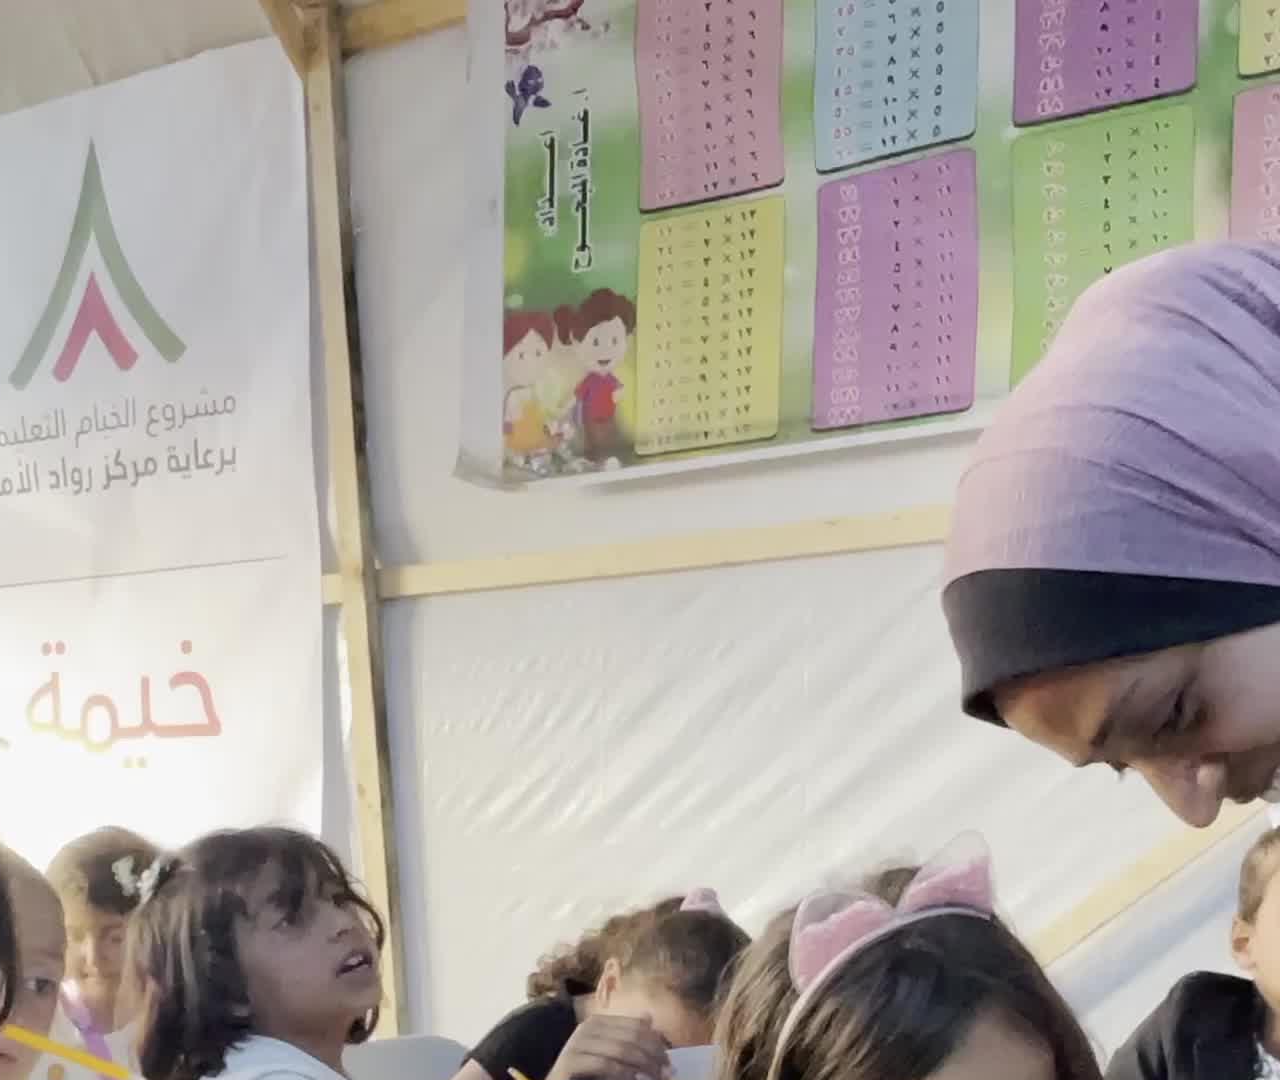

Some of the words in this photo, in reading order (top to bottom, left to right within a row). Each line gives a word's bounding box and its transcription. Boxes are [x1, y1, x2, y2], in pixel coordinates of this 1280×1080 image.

[935, 0, 945, 14] ٥
[887, 13, 897, 24] ٦
[935, 21, 944, 35] ٥
[887, 32, 897, 46] ٧
[935, 42, 944, 56] ٥
[887, 55, 897, 66] ٨
[935, 63, 944, 76] ٥
[887, 74, 896, 86] ٩
[933, 84, 943, 97] ٥
[882, 95, 898, 107] ١٠
[933, 104, 943, 117] ٥
[882, 113, 897, 127] ١١
[932, 124, 942, 138] ٥
[881, 135, 898, 148] ١٢
[145, 387, 237, 438] مشروع
[75, 395, 137, 448] الخيام
[167, 438, 238, 479] برعاية
[49, 456, 93, 496] رواد
[103, 449, 157, 490] مركز
[26, 640, 221, 769] خيمة
